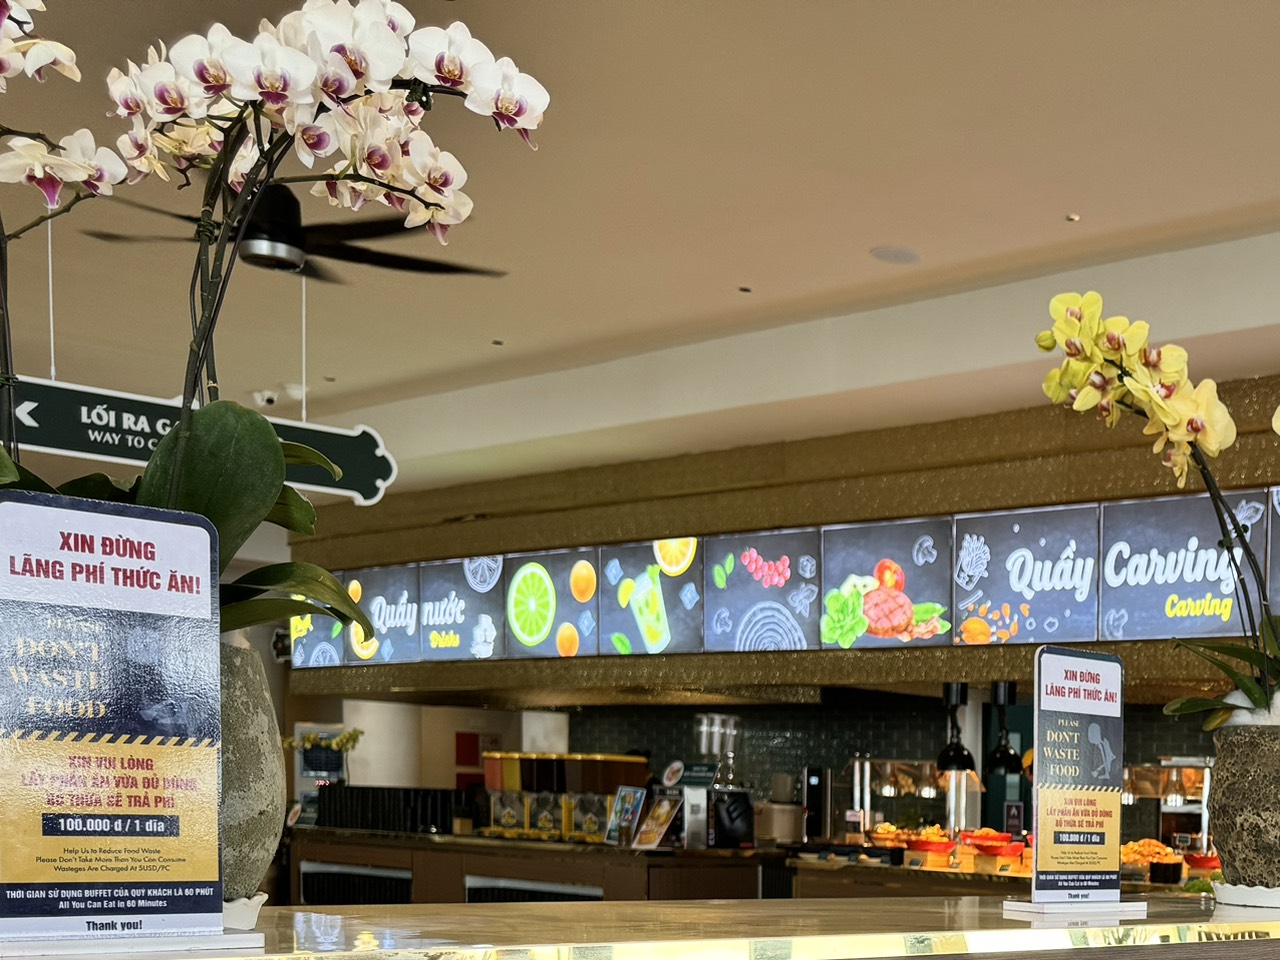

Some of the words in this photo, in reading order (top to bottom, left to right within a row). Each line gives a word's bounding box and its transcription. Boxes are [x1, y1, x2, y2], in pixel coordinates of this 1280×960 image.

[81, 404, 116, 428] LỐI
[122, 412, 151, 433] RA
[88, 429, 121, 445] WAY
[125, 435, 145, 449] TO
[59, 531, 95, 554] XIN
[101, 534, 156, 561] ĐỪNG
[9, 553, 65, 580] LÃNG
[71, 562, 105, 584] PHÍ
[111, 566, 161, 590] THỨC
[167, 570, 201, 594] ĂN!
[1006, 539, 1095, 602] Quầy
[1104, 536, 1243, 595] Carving
[422, 590, 466, 626] nước
[1165, 592, 1233, 622] Carving
[1064, 669, 1078, 682] XIN
[1045, 682, 1066, 697] LÃNG
[1068, 685, 1081, 699] PHÍ
[1083, 687, 1102, 702] THỨC
[1046, 730, 1080, 744] DON'T
[1043, 747, 1080, 760] WASTE
[120, 755, 154, 770] LÒNG
[1050, 764, 1080, 777] FOOD
[127, 791, 151, 808] TRẢ
[58, 818, 111, 832] 100.000
[134, 819, 140, 832] 1
[63, 847, 79, 856] Help
[100, 865, 129, 873] Charged
[6, 889, 24, 899] THỜI
[26, 890, 46, 899] GIAN
[61, 889, 83, 900] DỤNG
[84, 889, 112, 898] BUFFET
[113, 887, 129, 898] CỦA
[147, 887, 172, 897] KHÁCH
[174, 887, 183, 896] LÀ
[184, 888, 194, 896] 60
[195, 887, 214, 896] PHÚT
[58, 901, 70, 909] All
[71, 901, 85, 909] You
[87, 900, 102, 909] Can
[104, 900, 116, 908] Eat
[126, 900, 136, 908] 60
[138, 899, 167, 908] Minutes
[86, 921, 118, 932] Thank
[120, 919, 143, 932] you!
